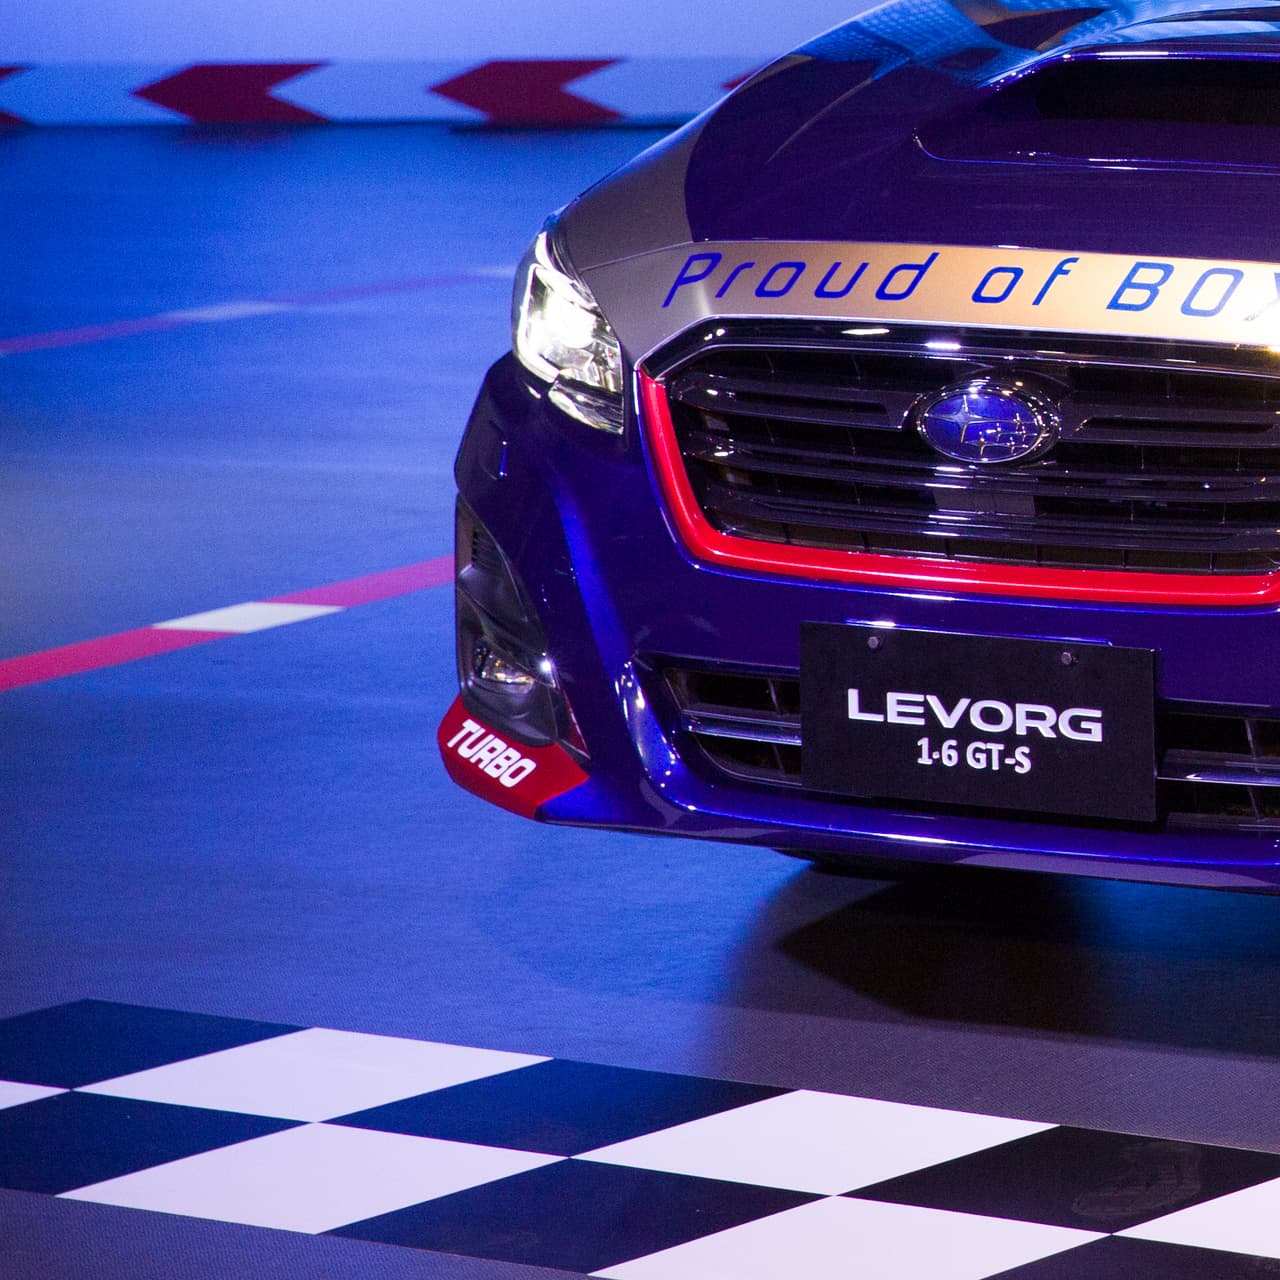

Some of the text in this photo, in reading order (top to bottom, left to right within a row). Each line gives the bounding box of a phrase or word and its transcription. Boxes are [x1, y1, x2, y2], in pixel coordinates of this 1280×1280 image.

[661, 252, 940, 308] Proud
[971, 257, 1080, 306] of
[847, 688, 1103, 742] LEVORG
[447, 719, 537, 788] TURBO
[966, 741, 1032, 774] GT-S
